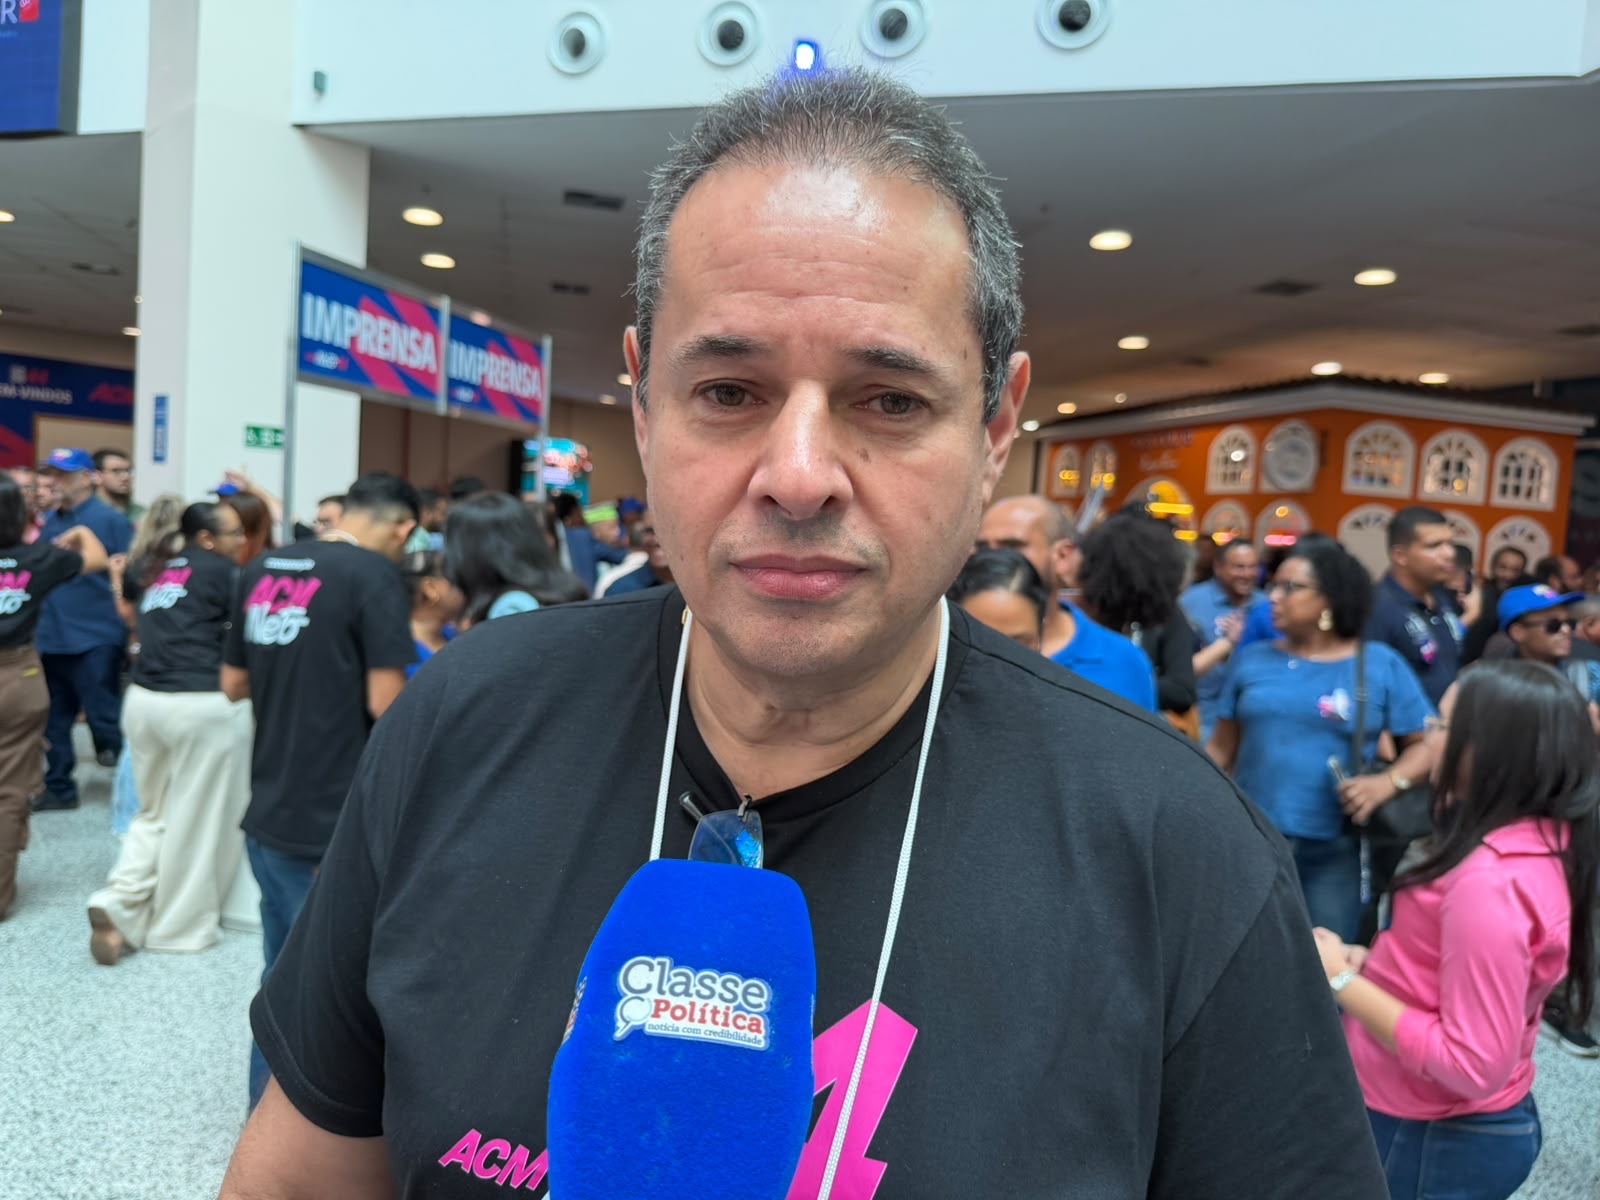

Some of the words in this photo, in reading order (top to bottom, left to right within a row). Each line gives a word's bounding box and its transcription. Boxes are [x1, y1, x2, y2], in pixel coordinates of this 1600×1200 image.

[302, 291, 438, 374] IMPRENSA
[451, 339, 543, 402] IMPRENSA
[622, 959, 766, 1010] Classe
[648, 1023, 680, 1033] notícia
[682, 1026, 702, 1035] com
[703, 1027, 762, 1046] credibilidade
[651, 999, 763, 1034] Política
[438, 1128, 549, 1191] ACM
